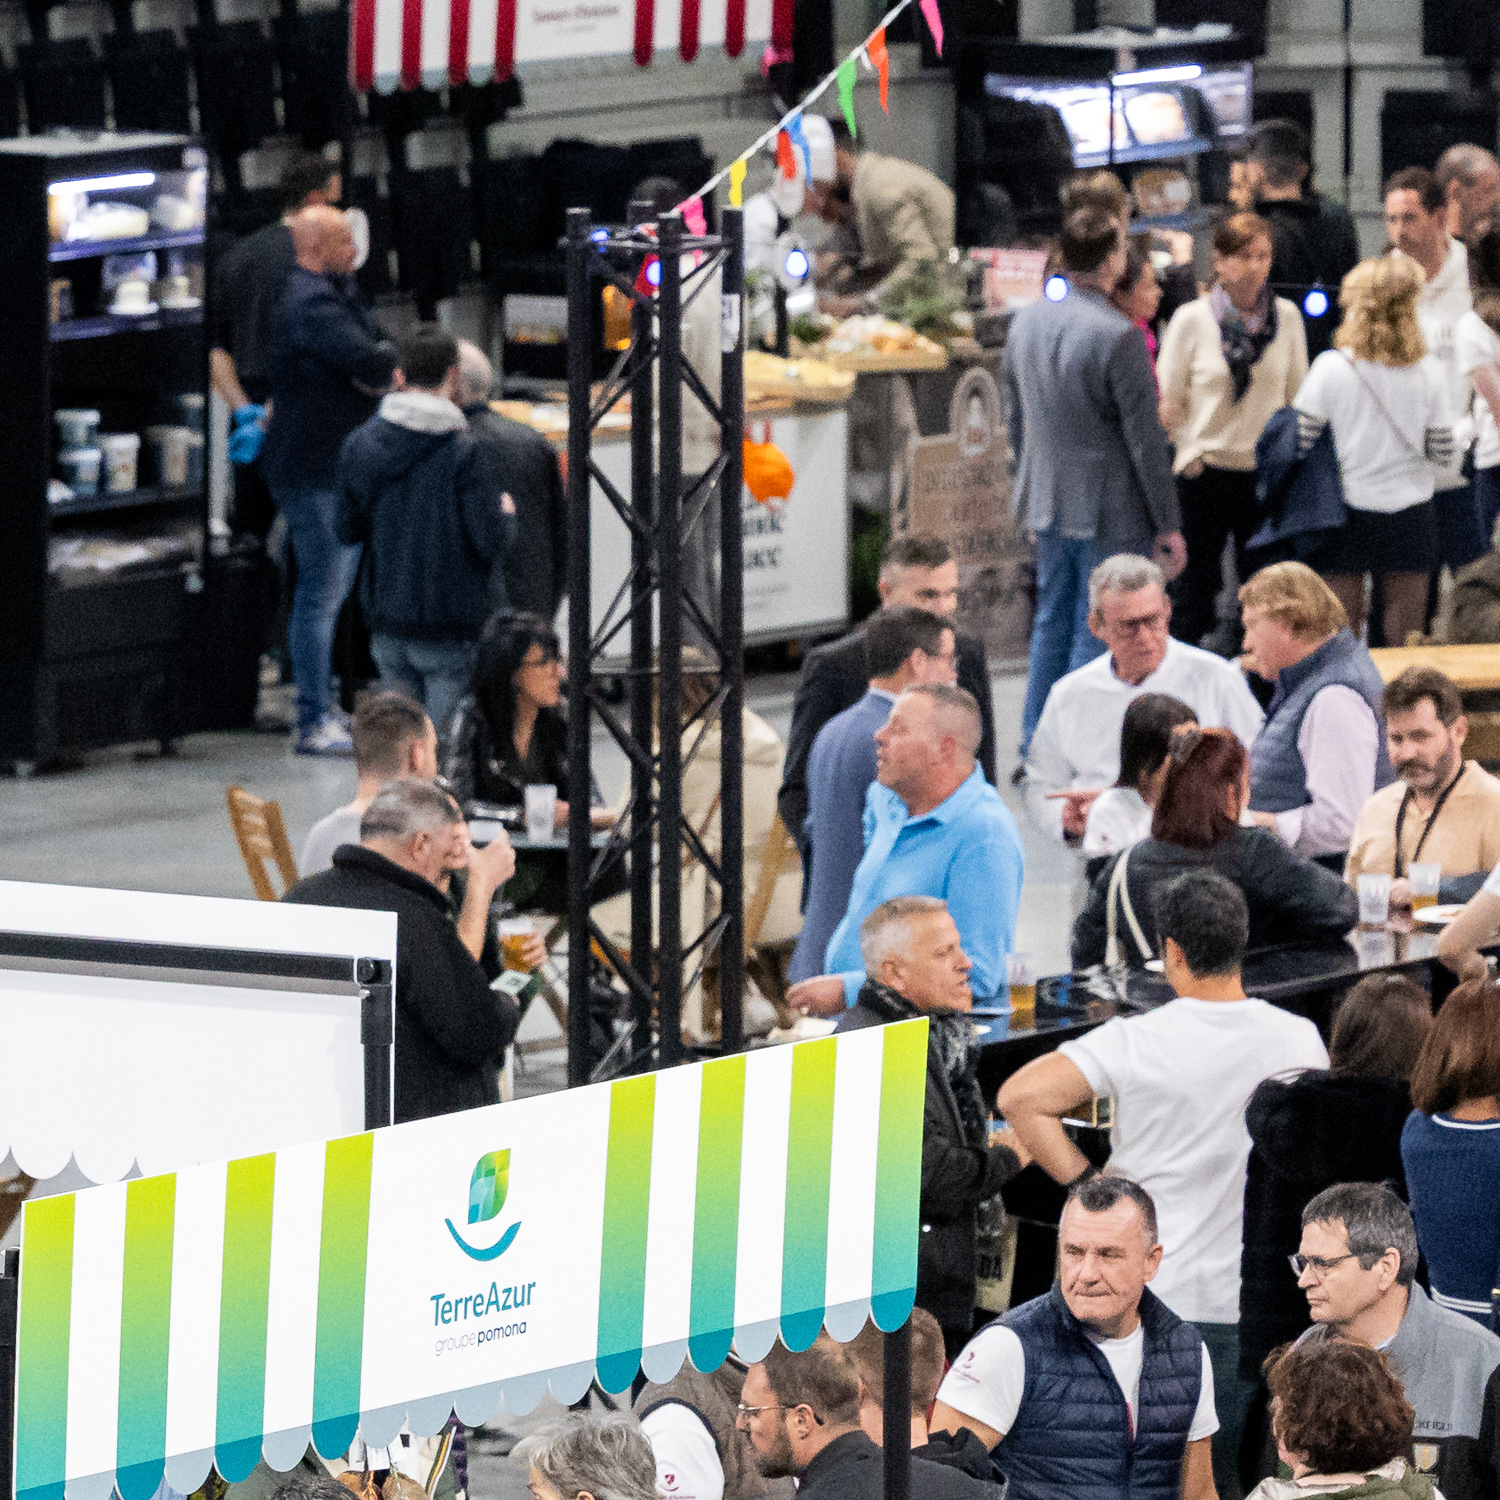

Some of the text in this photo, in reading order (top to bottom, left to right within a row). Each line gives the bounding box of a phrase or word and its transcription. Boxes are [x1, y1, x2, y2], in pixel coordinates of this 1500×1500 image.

[430, 1281, 536, 1326] TerreAzur
[435, 1321, 527, 1356] groupe pomona
